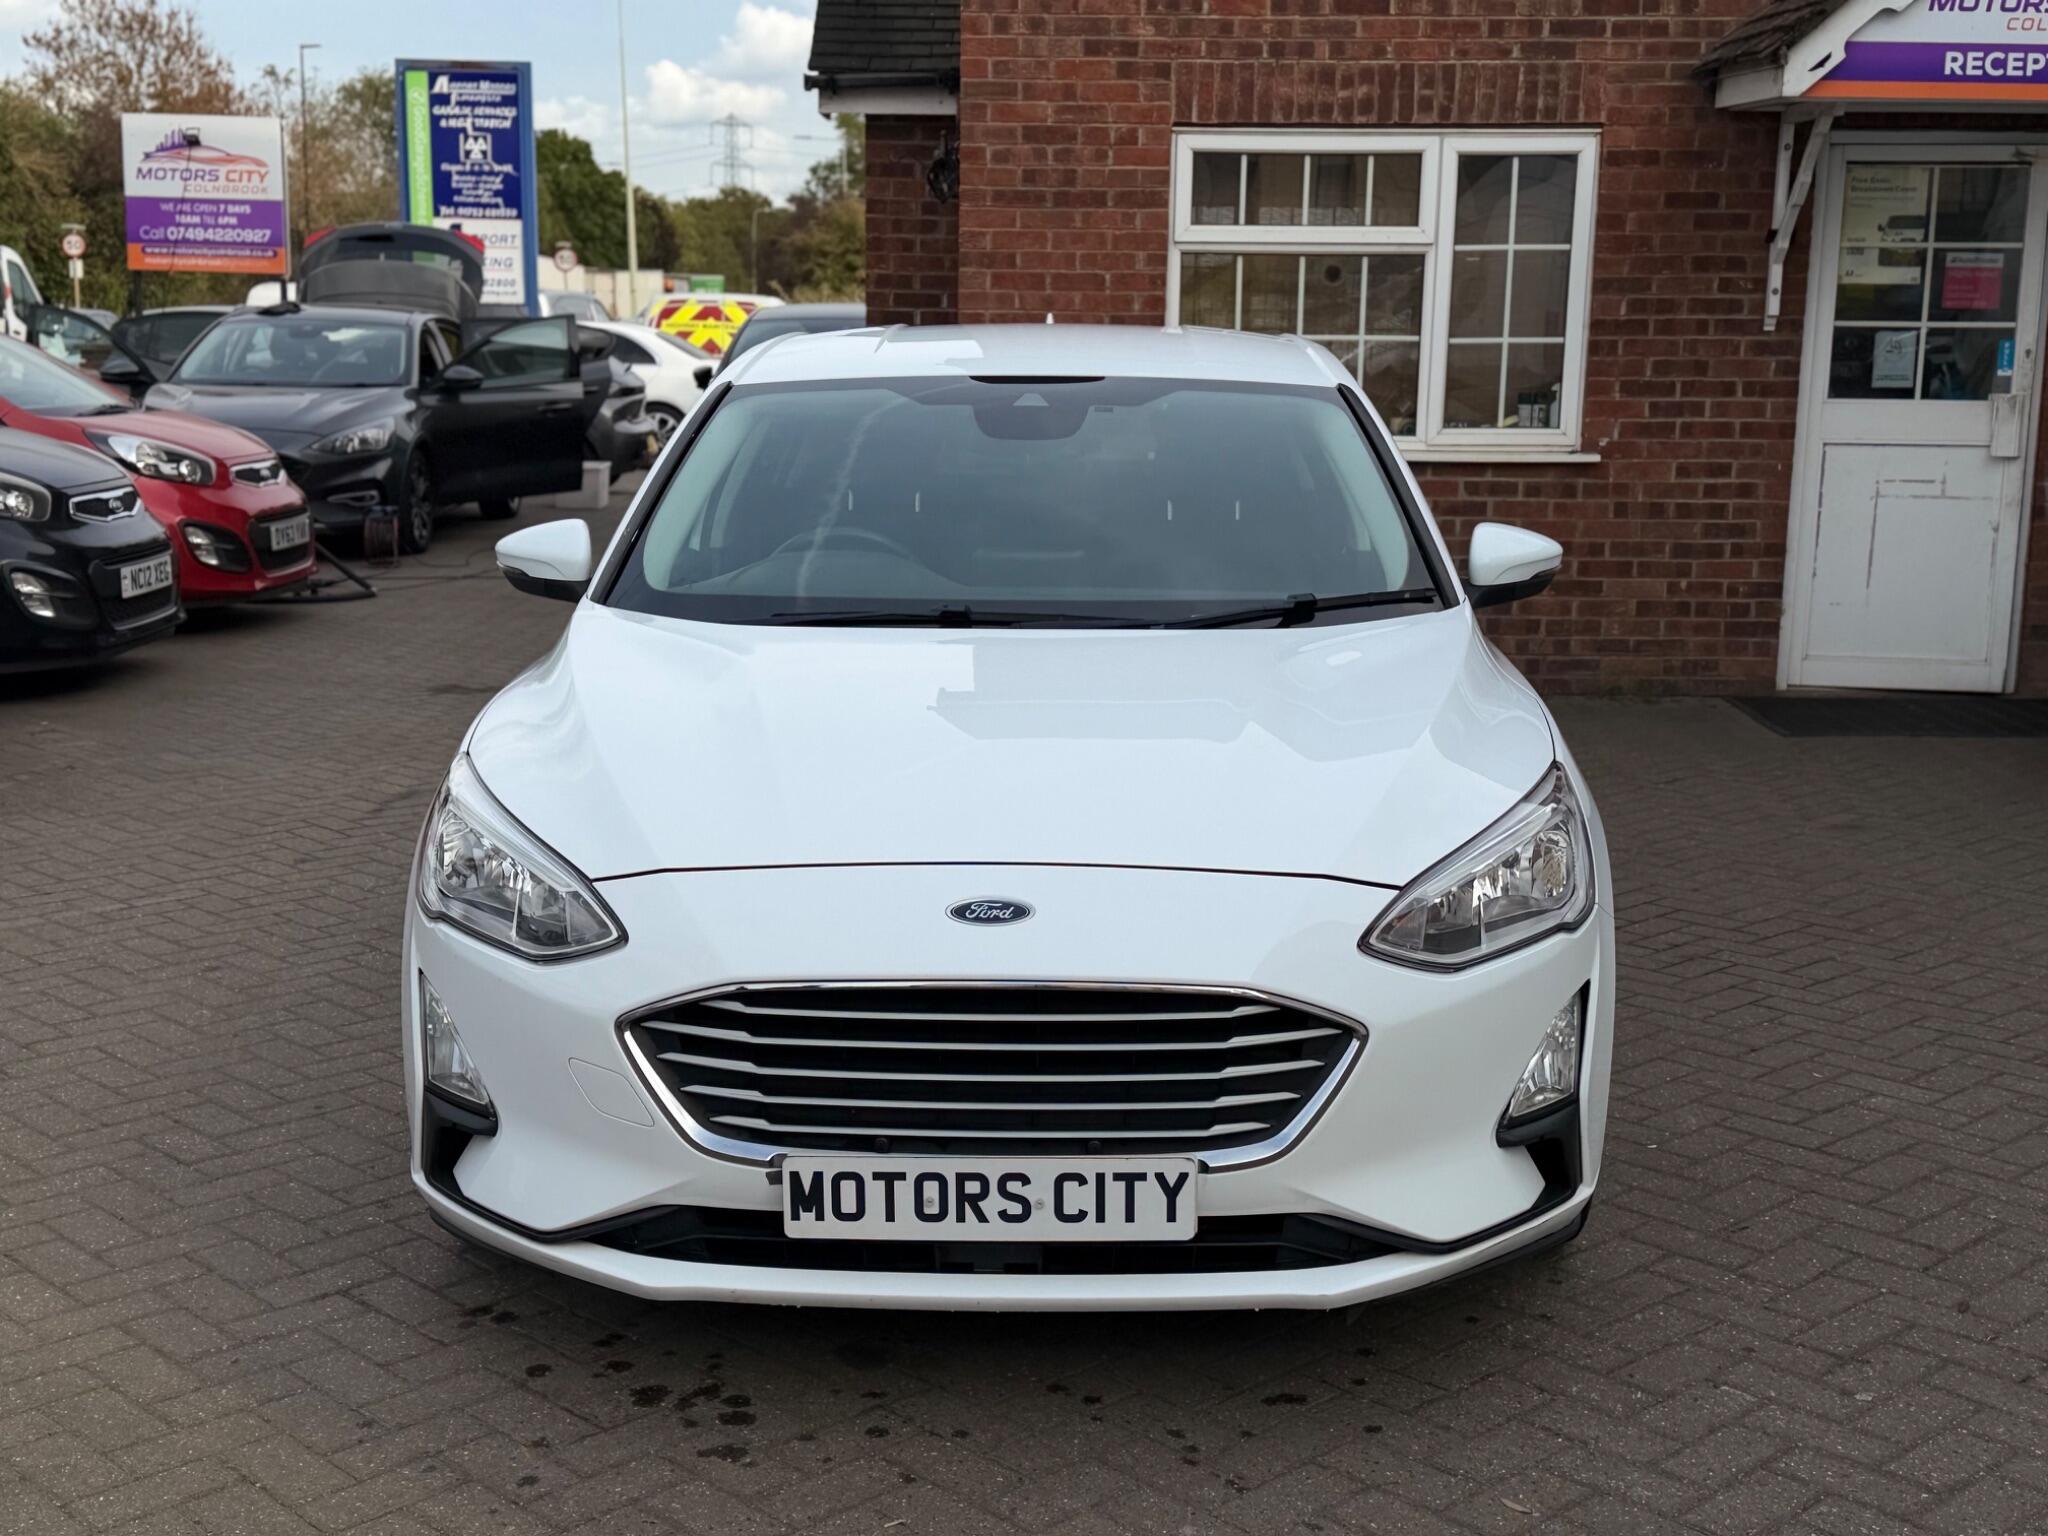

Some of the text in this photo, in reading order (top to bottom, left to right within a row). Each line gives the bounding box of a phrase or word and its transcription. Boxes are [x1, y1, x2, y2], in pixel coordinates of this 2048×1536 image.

[1928, 0, 2048, 13] MOTOR
[1944, 51, 2048, 76] RECEP
[136, 166, 269, 183] MOTORS CITY
[184, 184, 268, 195] COLNBROOK
[227, 205, 251, 215] DAYS
[139, 225, 165, 240] Call
[130, 565, 152, 592] NC12
[965, 902, 1015, 919] Ford
[789, 1170, 1190, 1224] MOTORS CITY
